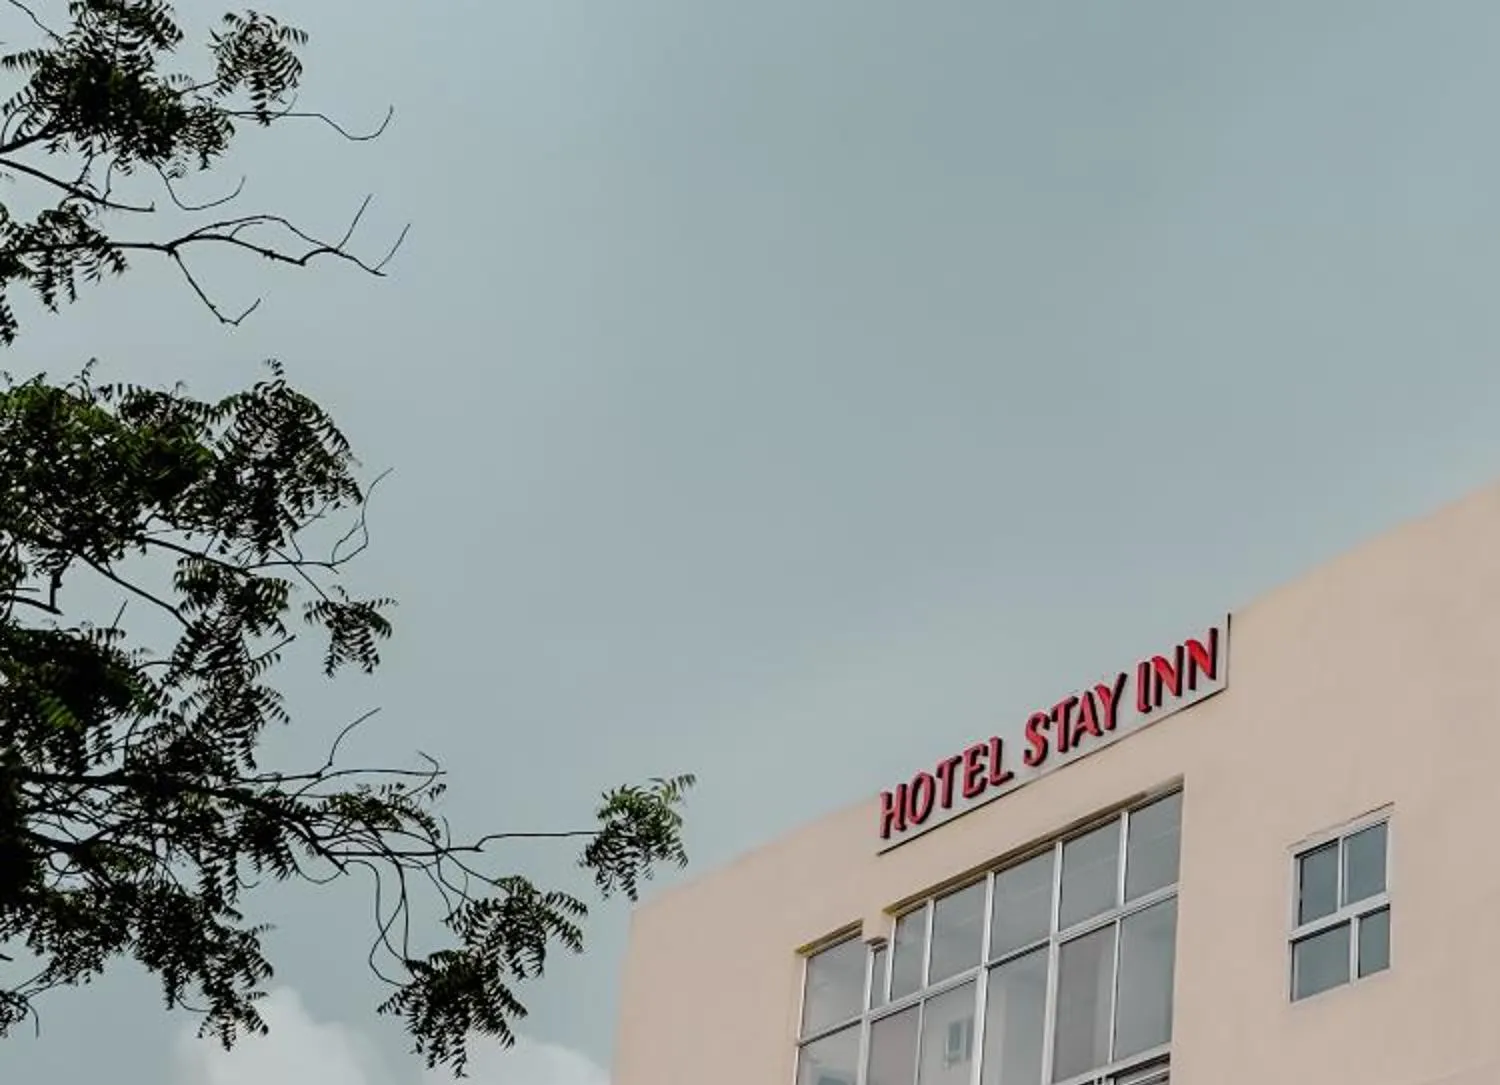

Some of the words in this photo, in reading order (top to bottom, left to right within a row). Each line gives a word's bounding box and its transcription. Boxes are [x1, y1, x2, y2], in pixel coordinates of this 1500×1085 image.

[879, 736, 1014, 839] HOTEL
[1023, 672, 1128, 767] STAY
[1136, 627, 1218, 713] INN
